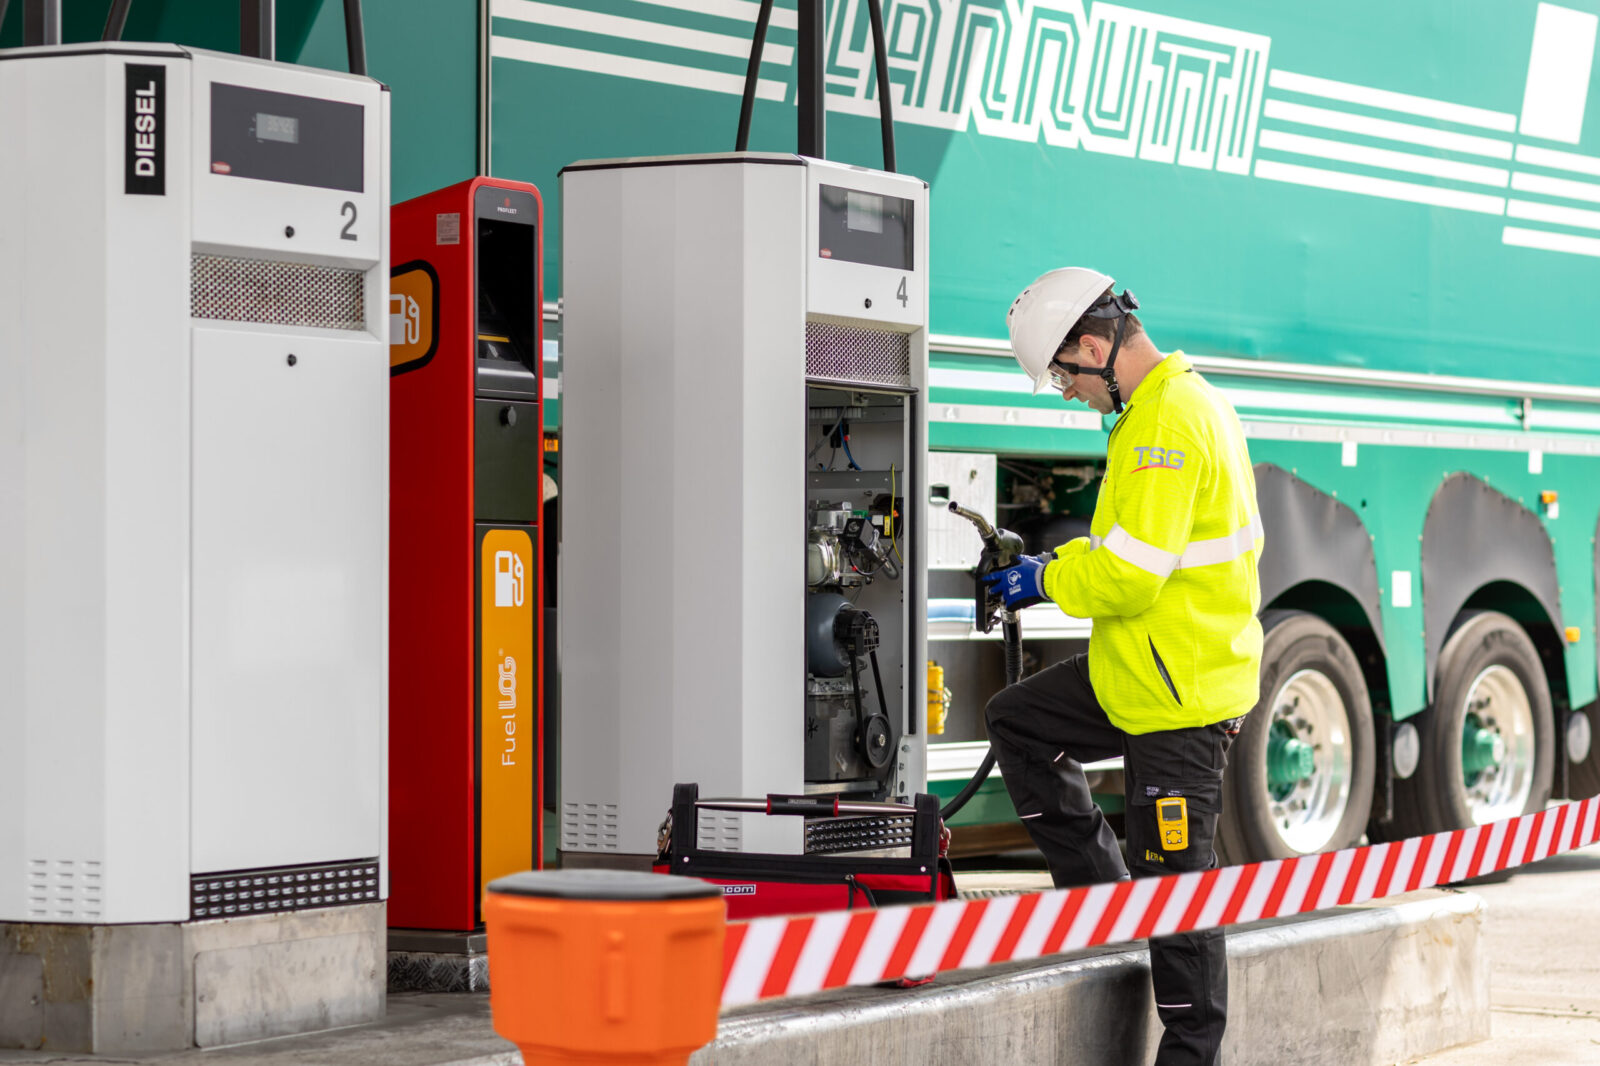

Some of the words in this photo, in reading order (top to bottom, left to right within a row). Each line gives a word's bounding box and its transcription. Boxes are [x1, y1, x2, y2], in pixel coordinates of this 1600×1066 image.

[135, 80, 155, 176] DIESEL
[340, 201, 357, 241] 2
[896, 276, 908, 308] 4
[1133, 446, 1186, 469] TSG
[501, 713, 516, 766] Fuel
